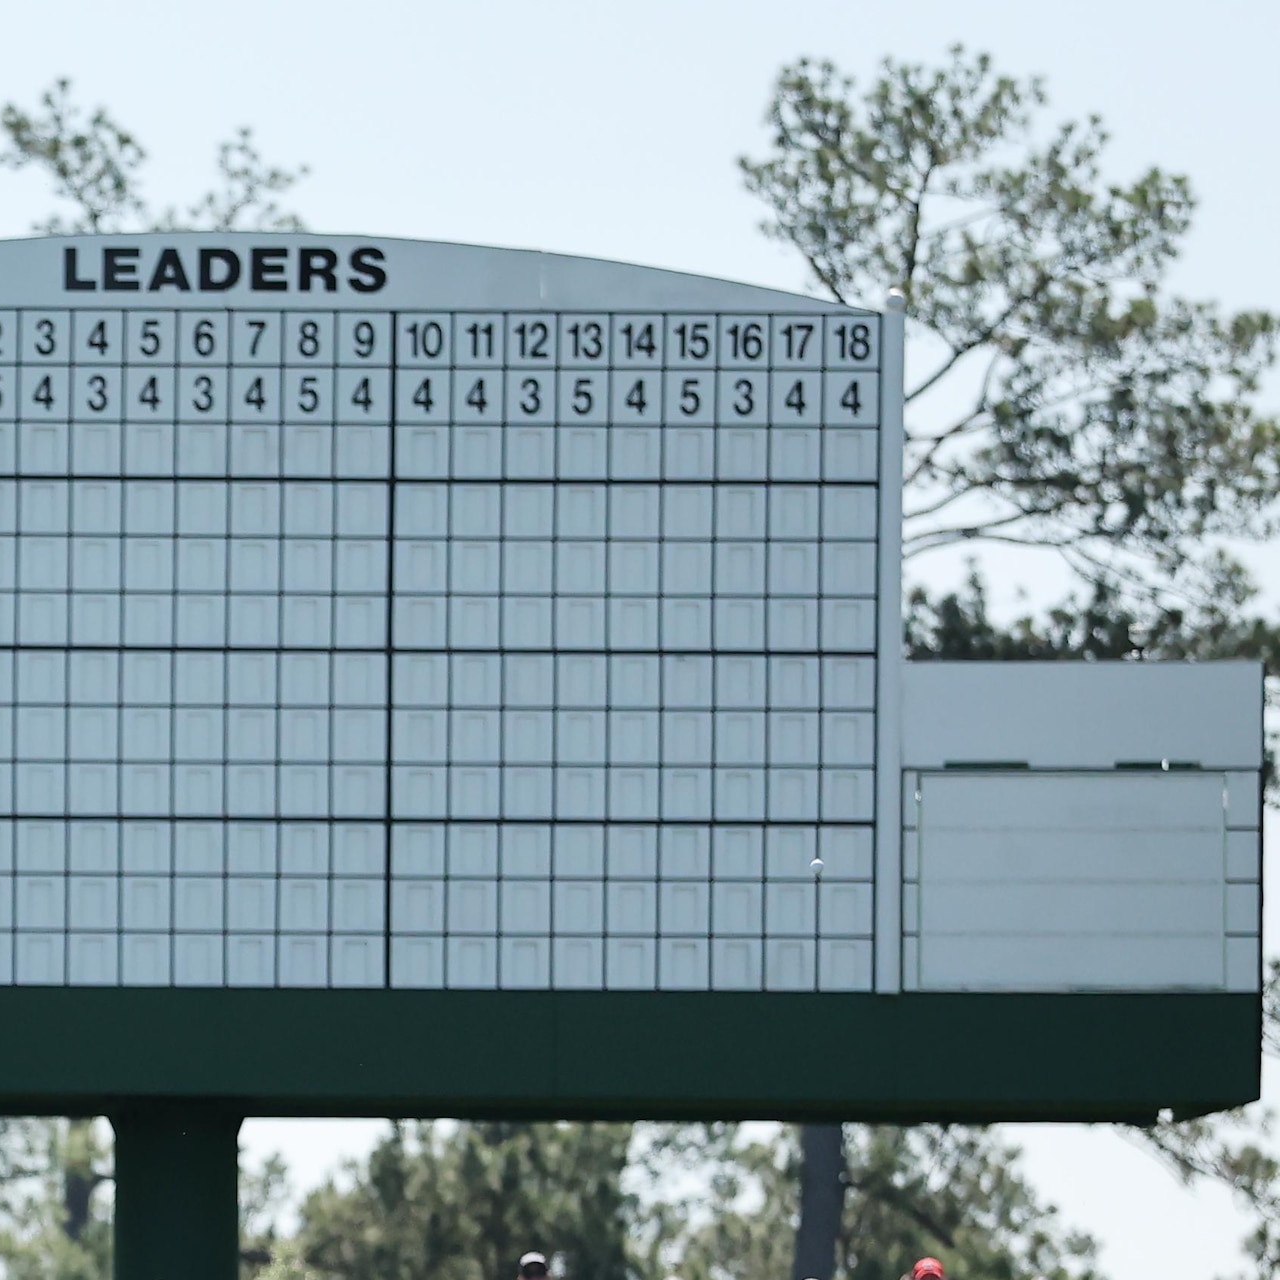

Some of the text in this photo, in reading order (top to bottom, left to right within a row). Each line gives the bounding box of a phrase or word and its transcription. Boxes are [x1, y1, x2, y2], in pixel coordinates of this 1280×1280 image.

[64, 246, 388, 294] LEADERS
[35, 319, 56, 356] 3
[87, 320, 109, 356] 4
[140, 320, 160, 356] 5
[194, 319, 215, 357] 6
[247, 320, 267, 356] 7
[298, 320, 320, 358] 8
[354, 321, 375, 359] 9
[406, 321, 443, 359] 10
[467, 322, 493, 358] 11
[514, 321, 549, 359] 12
[568, 322, 603, 360] 13
[621, 323, 657, 359] 14
[675, 323, 710, 360] 15
[727, 323, 763, 361] 16
[781, 324, 815, 360] 17
[834, 323, 871, 362] 18
[32, 375, 55, 411] 4
[87, 375, 108, 412] 3
[139, 375, 161, 411] 4
[193, 375, 214, 413] 5
[244, 376, 266, 413] 3
[298, 376, 319, 413] 4
[351, 377, 373, 413] 5
[412, 377, 434, 413] 4
[466, 377, 488, 414] 4
[520, 377, 541, 416] 3
[572, 378, 593, 416] 5
[625, 379, 647, 415] 4
[679, 378, 701, 417] 5
[733, 378, 755, 417] 3
[784, 379, 806, 417] 4
[840, 380, 862, 417] 4
